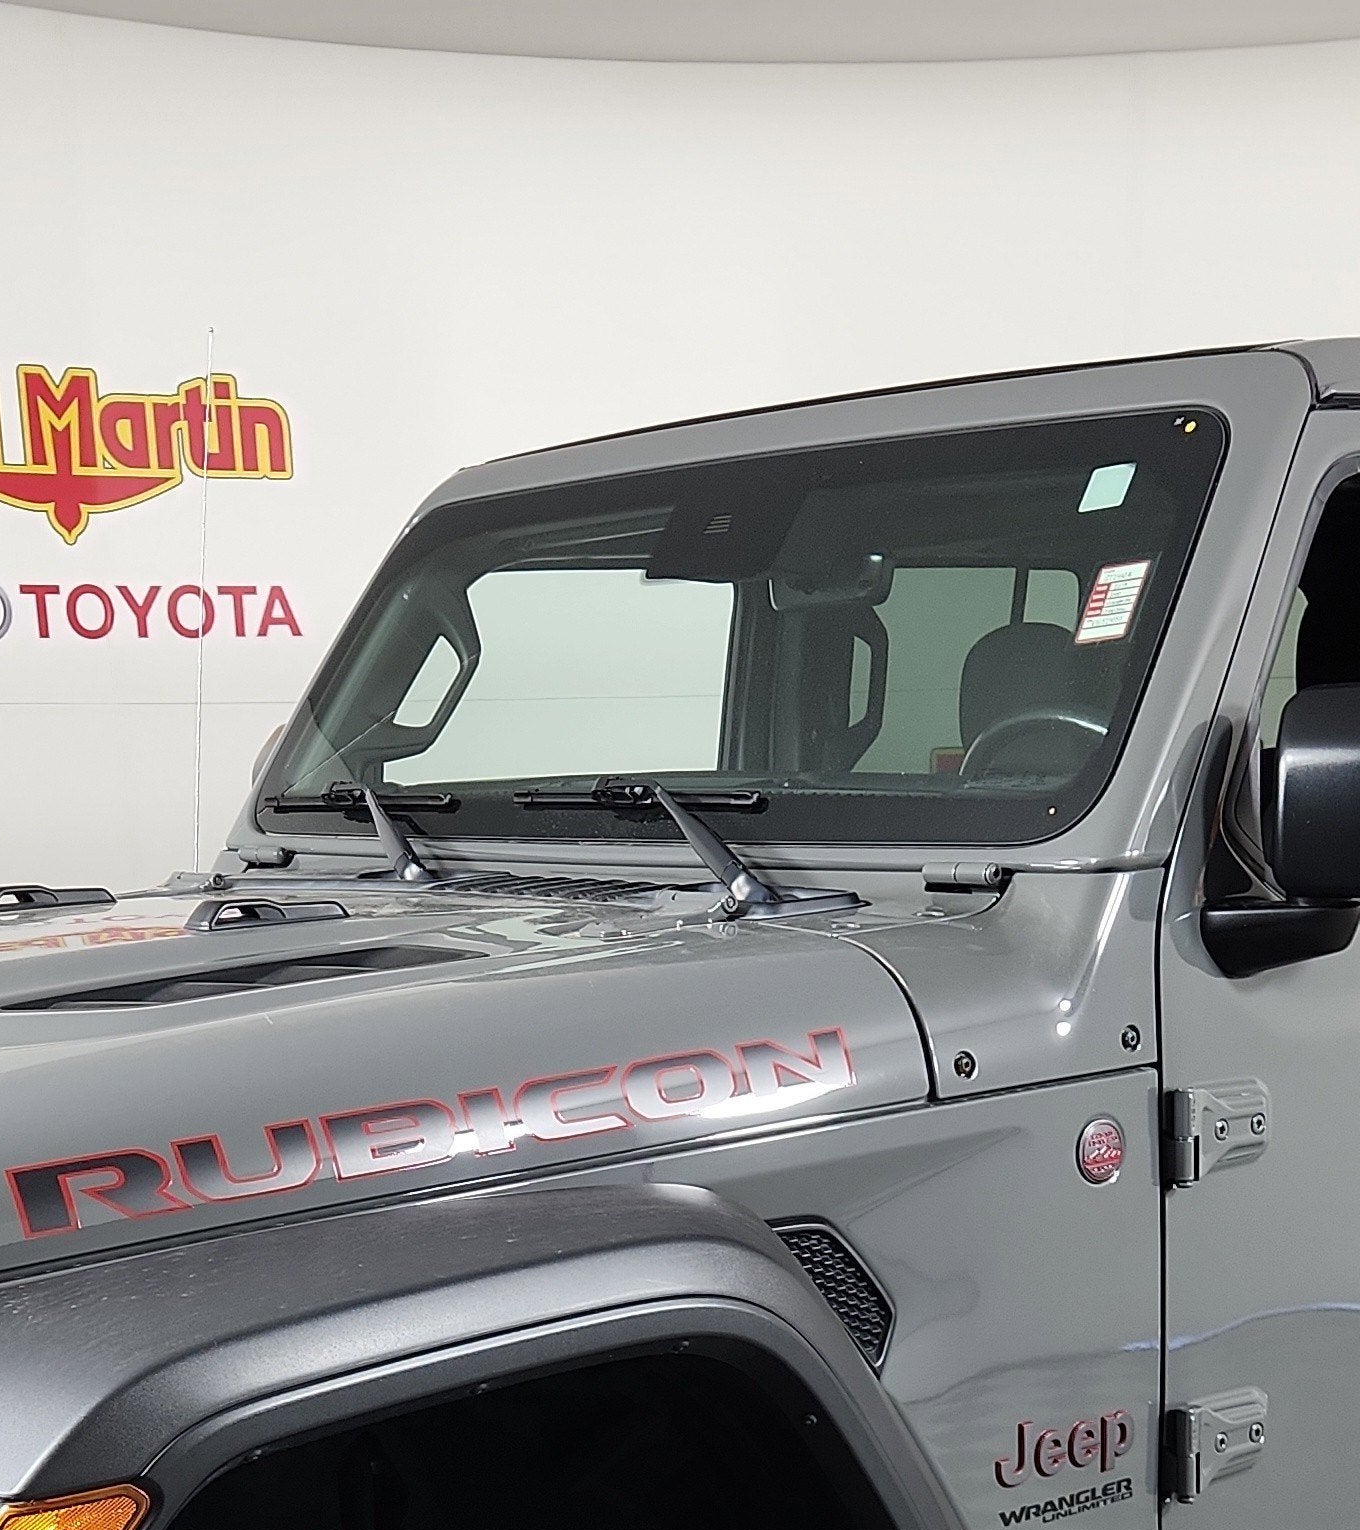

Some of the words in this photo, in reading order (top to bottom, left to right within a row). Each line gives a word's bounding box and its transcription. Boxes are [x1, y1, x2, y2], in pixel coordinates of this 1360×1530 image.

[17, 363, 294, 480] Martin
[20, 583, 303, 640] TOYOTA
[3, 1026, 858, 1240] RUBICON
[994, 1409, 1136, 1488] Jeep
[998, 1477, 1133, 1527] WRANGLER
[1042, 1491, 1133, 1524] UNLIMITED
